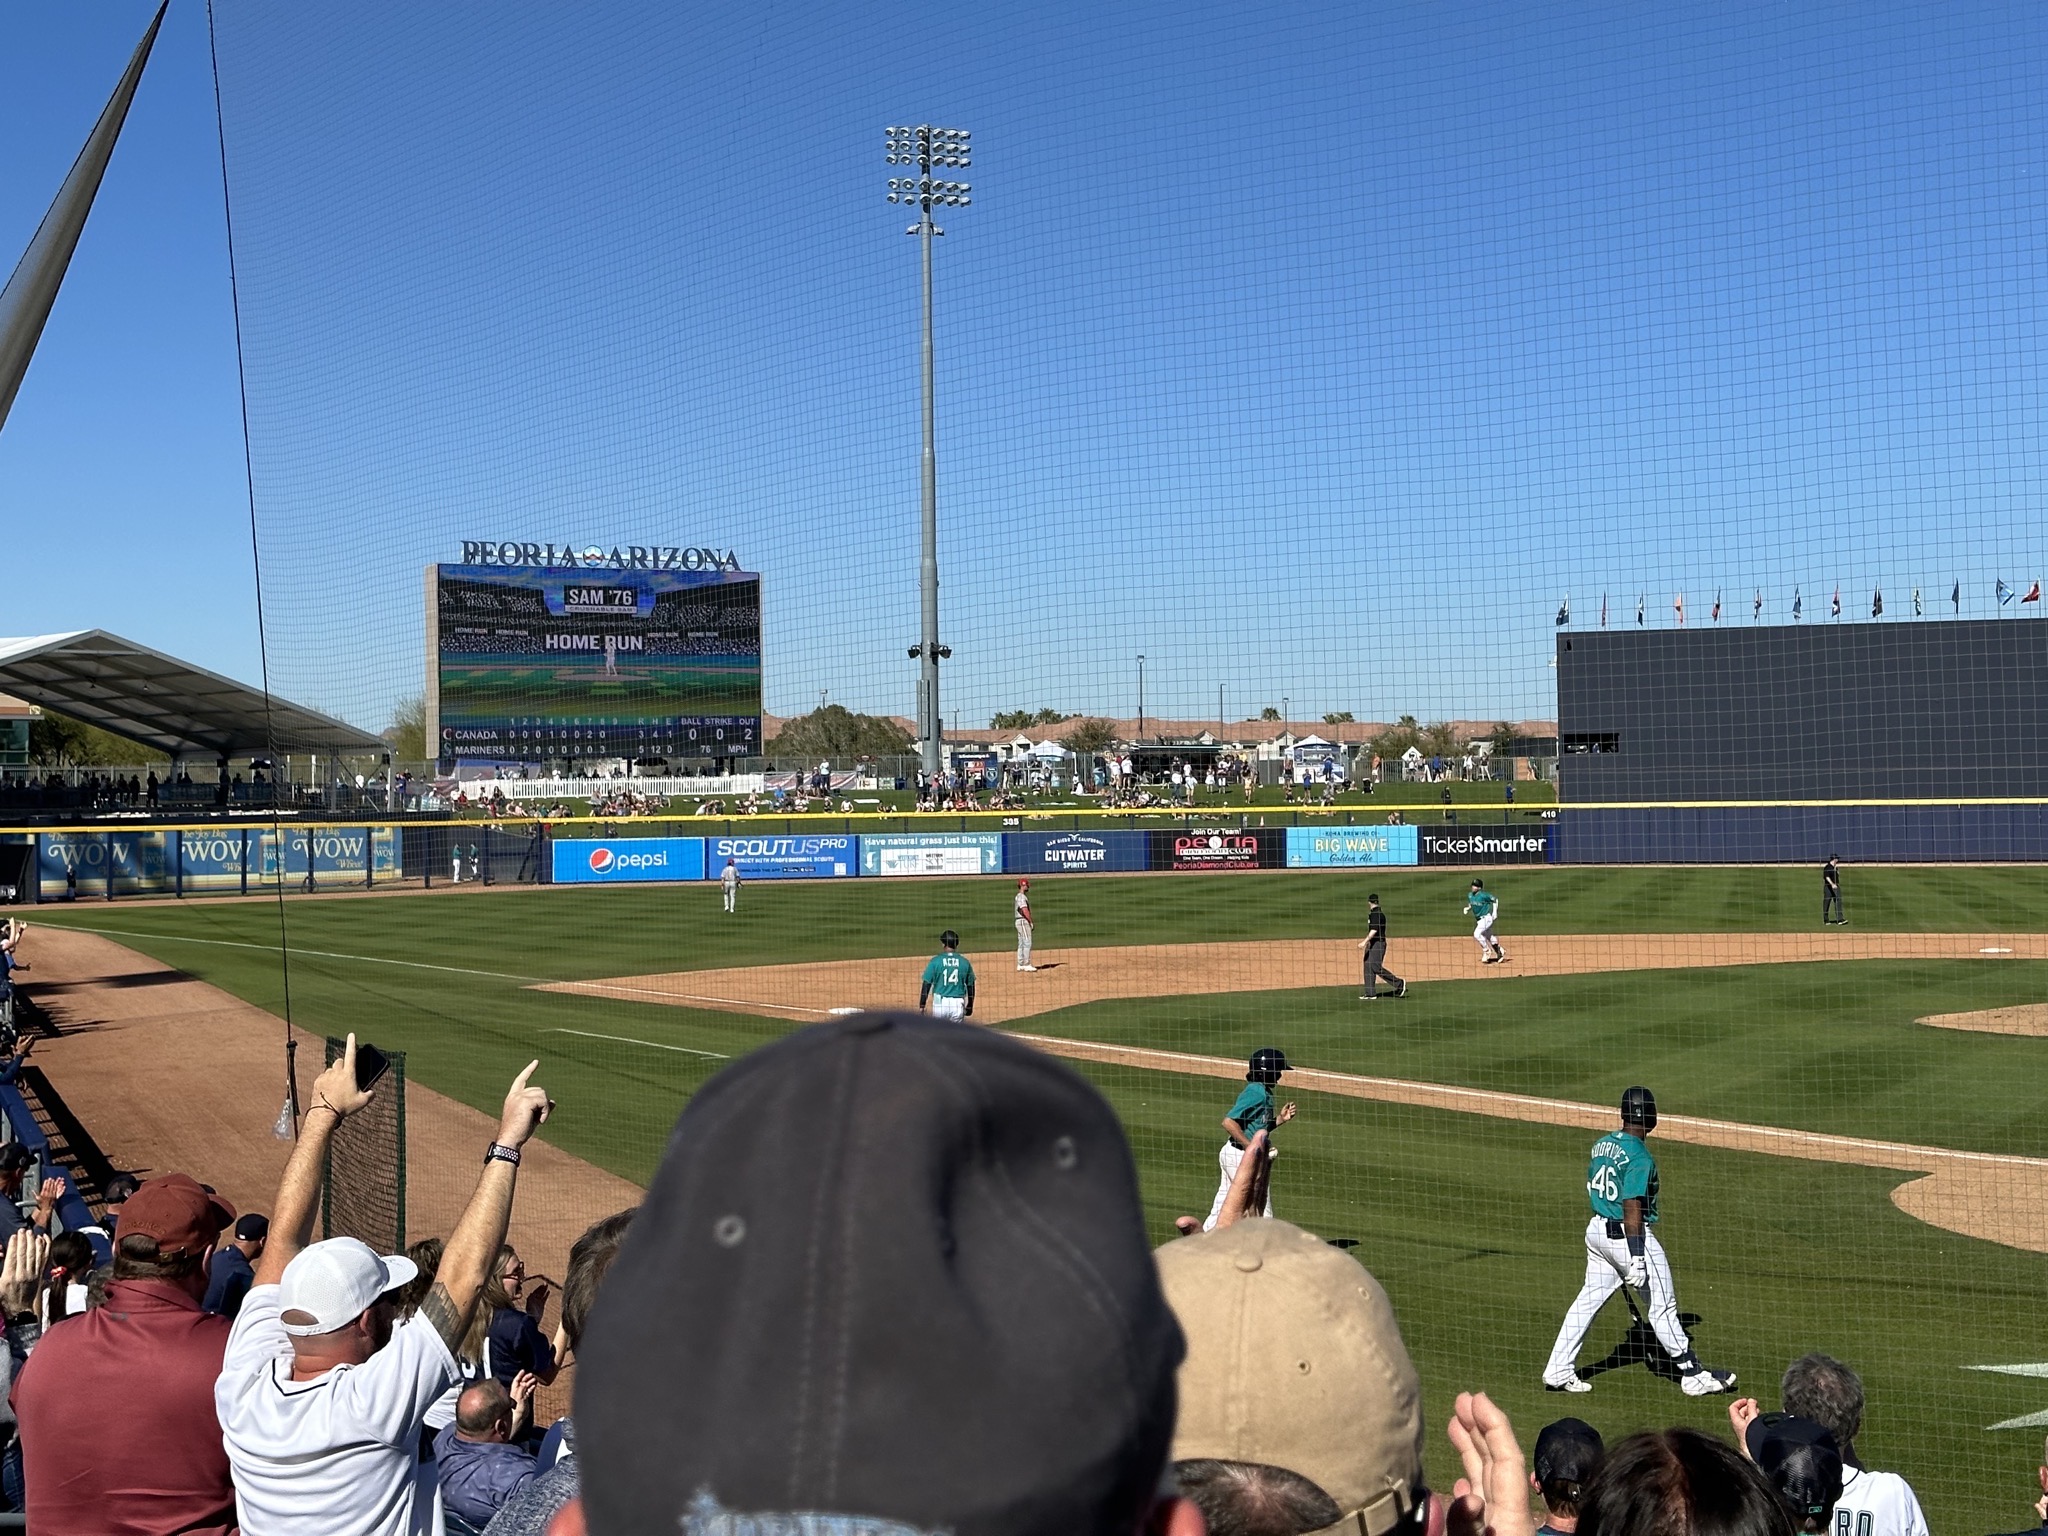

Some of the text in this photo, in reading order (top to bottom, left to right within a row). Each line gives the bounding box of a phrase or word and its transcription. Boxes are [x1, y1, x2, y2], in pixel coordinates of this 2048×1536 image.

[460, 540, 742, 572] PEORIA ARIZONA
[570, 589, 604, 605] SAM
[546, 634, 643, 650] HOME RUN
[455, 731, 498, 739] CANADA
[689, 729, 752, 740] 0 0 2
[455, 746, 505, 754] MARINERS
[728, 745, 747, 753] MPH
[292, 837, 364, 858] WOW
[864, 838, 886, 846] Have
[887, 837, 918, 845] natural
[920, 838, 942, 847] grass
[979, 836, 998, 844] this!
[1315, 839, 1388, 852] BIG WAVE
[1423, 835, 1544, 854] TicketSmarter
[48, 843, 129, 865] WOW
[182, 840, 253, 862] WOW
[1044, 849, 1104, 861] CUTWATER
[1330, 853, 1373, 863] Golden Ale
[618, 850, 667, 870] pepsi
[943, 968, 959, 986] 14
[1591, 1165, 1618, 1202] 46
